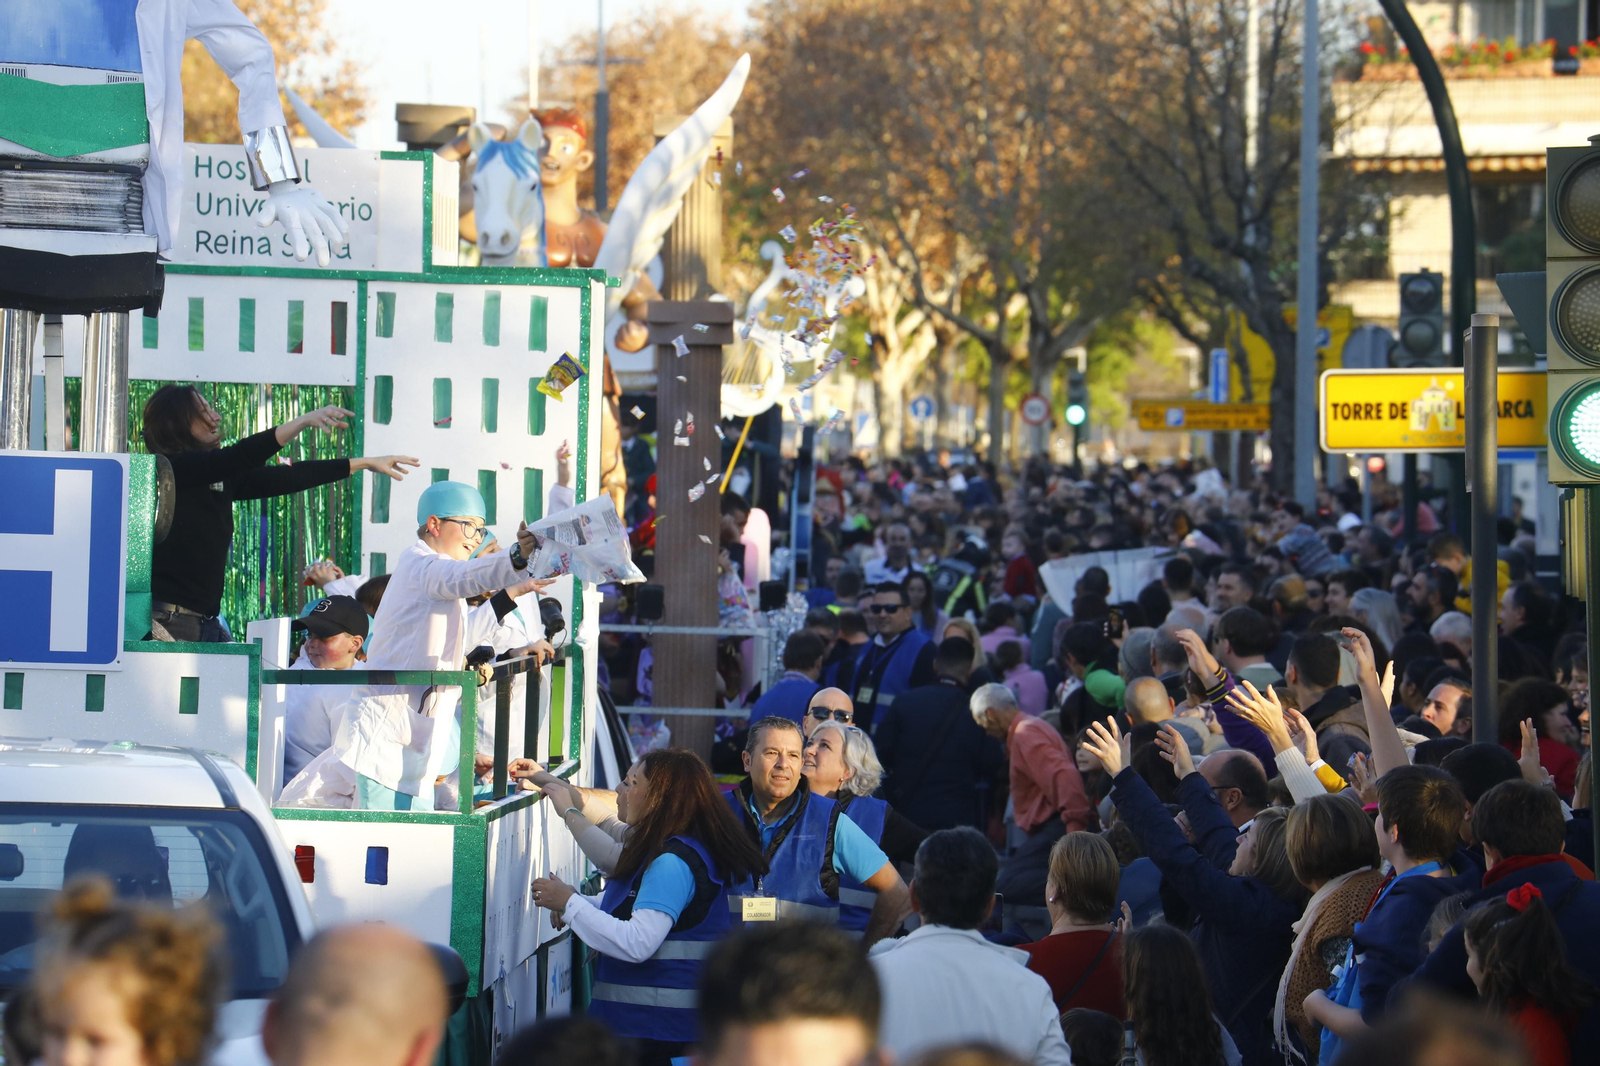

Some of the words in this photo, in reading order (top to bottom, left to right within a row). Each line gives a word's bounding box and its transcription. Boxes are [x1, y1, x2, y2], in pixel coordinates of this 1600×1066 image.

[195, 155, 311, 186] Hosl
[195, 230, 272, 257] Reina
[1331, 402, 1382, 420] TORRE
[1389, 402, 1408, 420] DE
